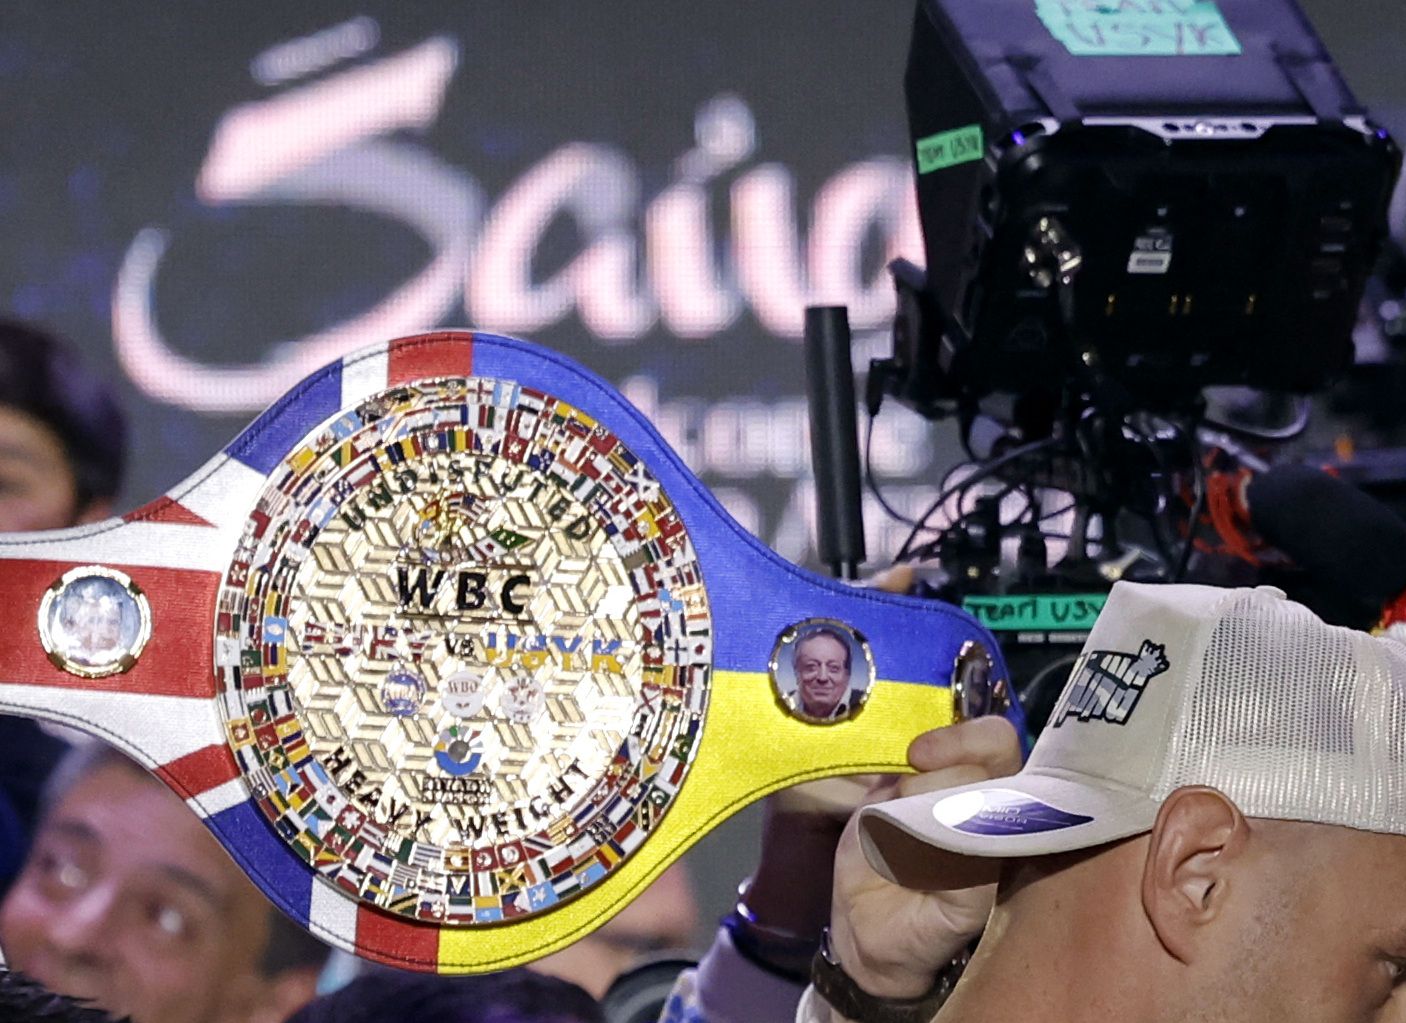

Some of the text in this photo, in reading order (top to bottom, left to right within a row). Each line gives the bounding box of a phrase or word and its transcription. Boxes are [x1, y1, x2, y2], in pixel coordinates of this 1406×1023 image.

[341, 456, 592, 541] UNDISPUTED
[398, 569, 533, 615] WBC
[966, 600, 1103, 623] TEAM USY
[486, 631, 623, 675] USYK
[448, 679, 479, 695] WBO
